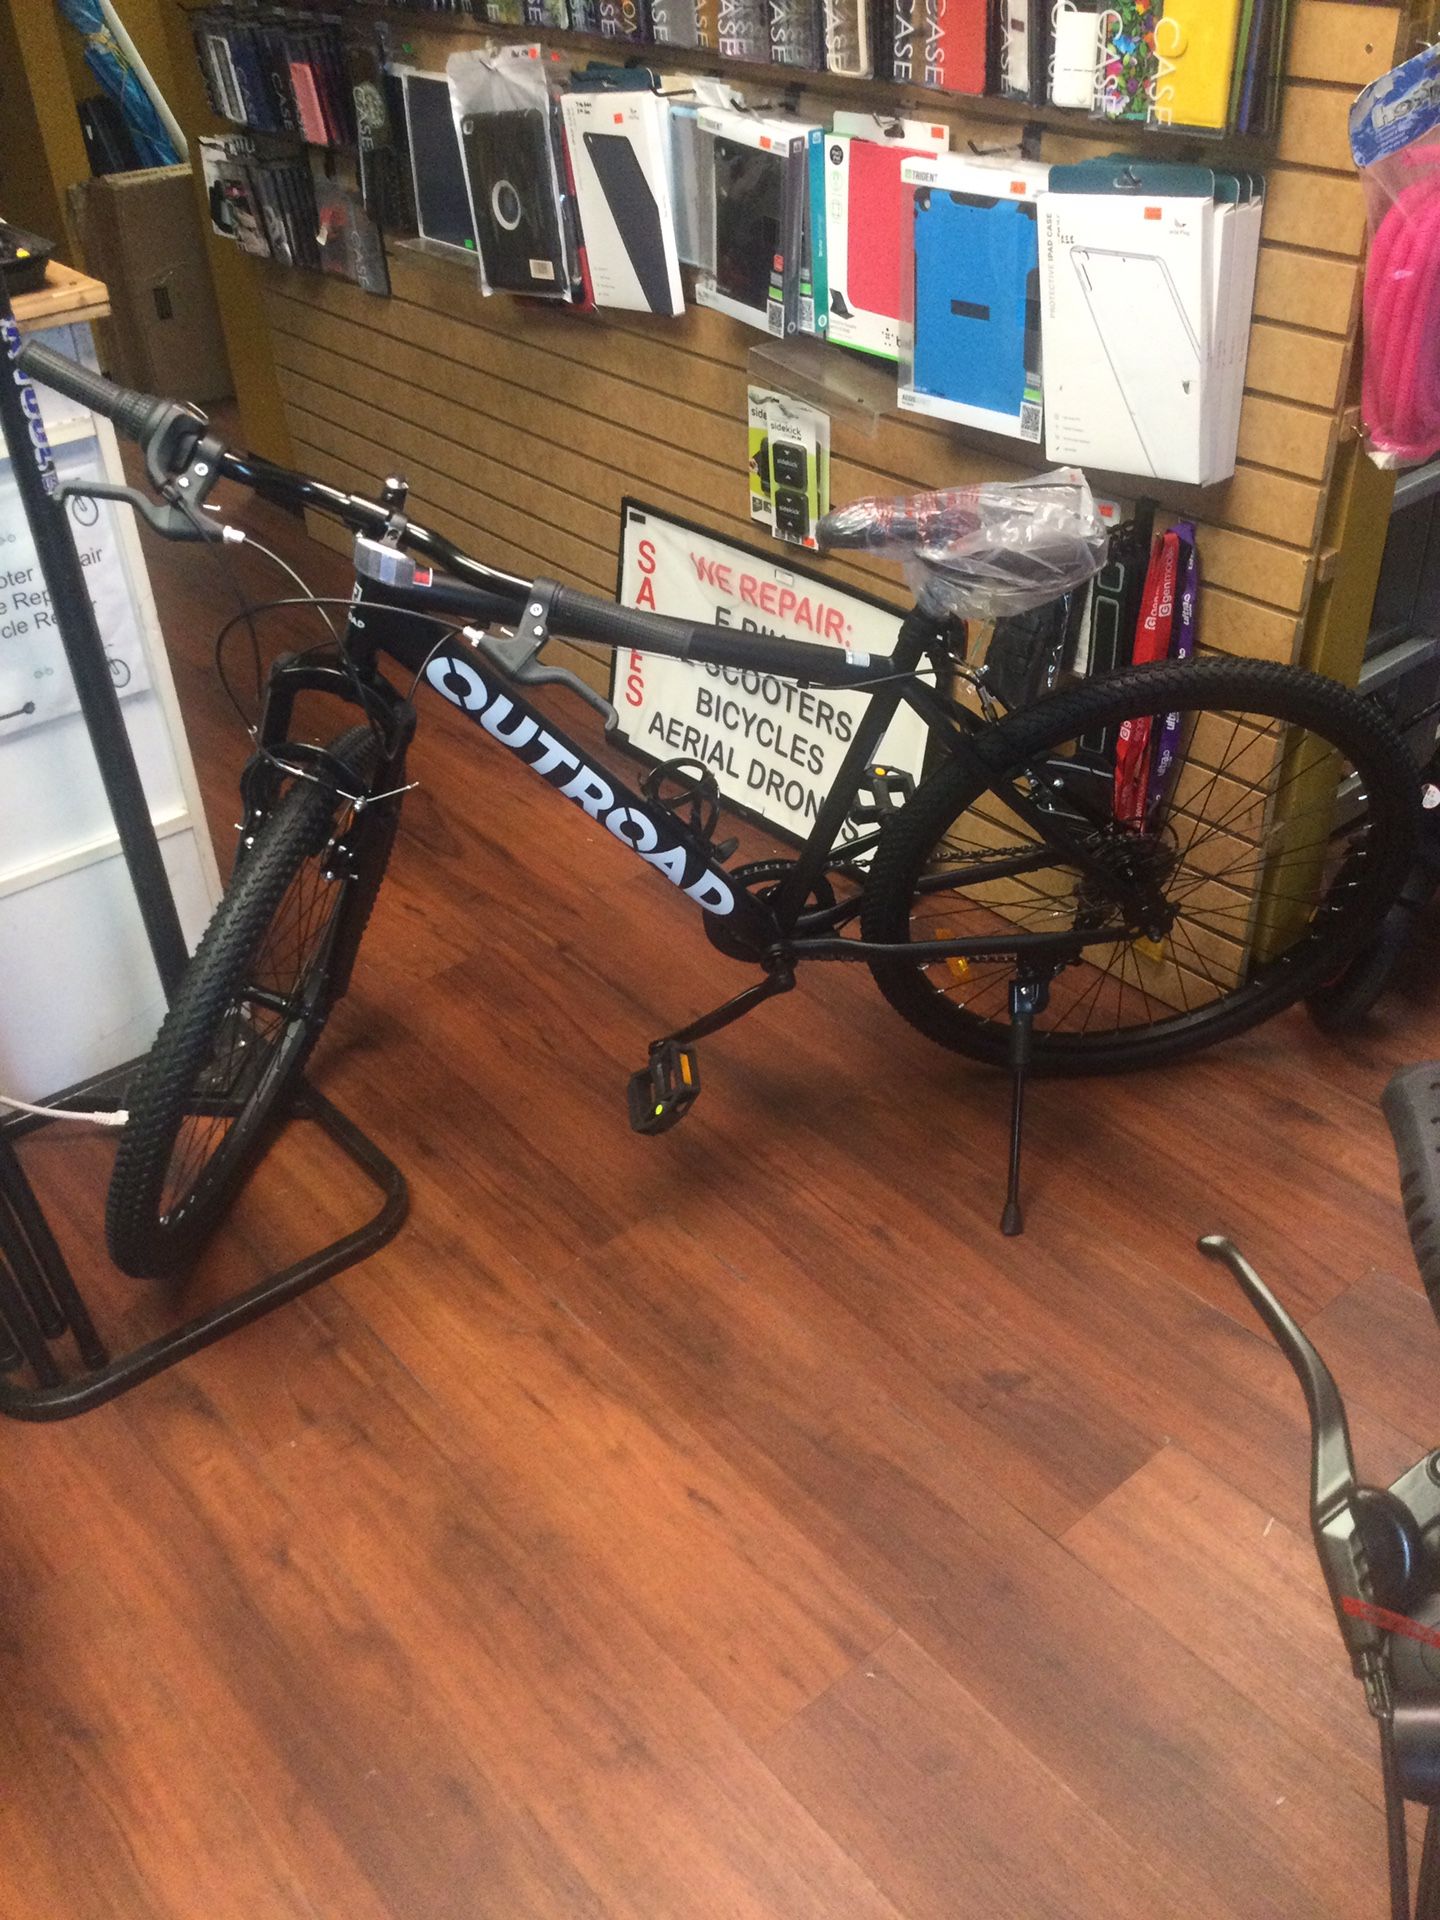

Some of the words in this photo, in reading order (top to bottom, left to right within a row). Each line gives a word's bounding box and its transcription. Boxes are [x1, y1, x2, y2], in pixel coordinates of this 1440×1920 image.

[1090, 9, 1123, 112] CASE
[1146, 16, 1181, 126] CASE
[770, 423, 802, 437] sidekick
[690, 551, 734, 597] WE
[738, 573, 853, 649] REPAIR:
[648, 711, 740, 780] AERIAL
[695, 686, 825, 776] BICYCLES
[426, 656, 735, 916] OUTROAD
